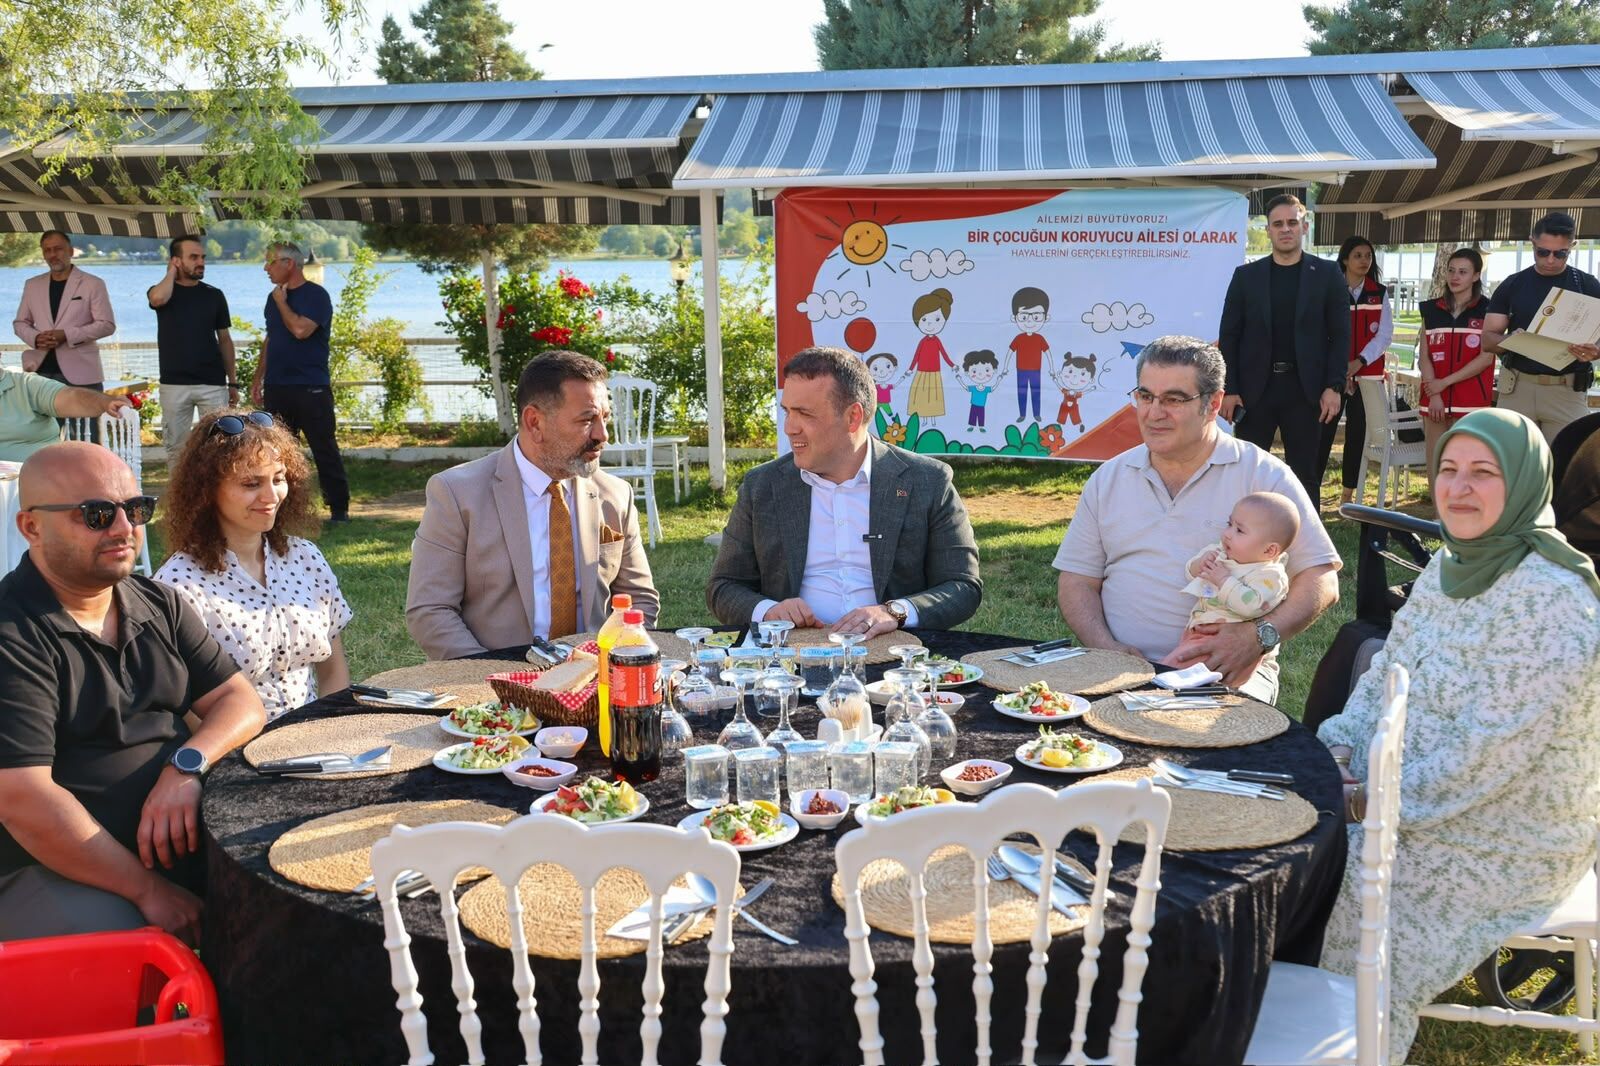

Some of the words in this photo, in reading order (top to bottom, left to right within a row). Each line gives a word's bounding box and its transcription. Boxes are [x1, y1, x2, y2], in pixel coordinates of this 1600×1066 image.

[1087, 213, 1168, 224] BÜYÜTÜYORUZ!
[968, 229, 990, 243] BİR
[993, 229, 1058, 246] ÇOCUĞUN
[1061, 231, 1133, 243] KORUYUCU
[1137, 229, 1178, 243] AİLESİ
[1183, 231, 1237, 244] OLARAK
[1011, 248, 1069, 258] HAYALLERİNİ
